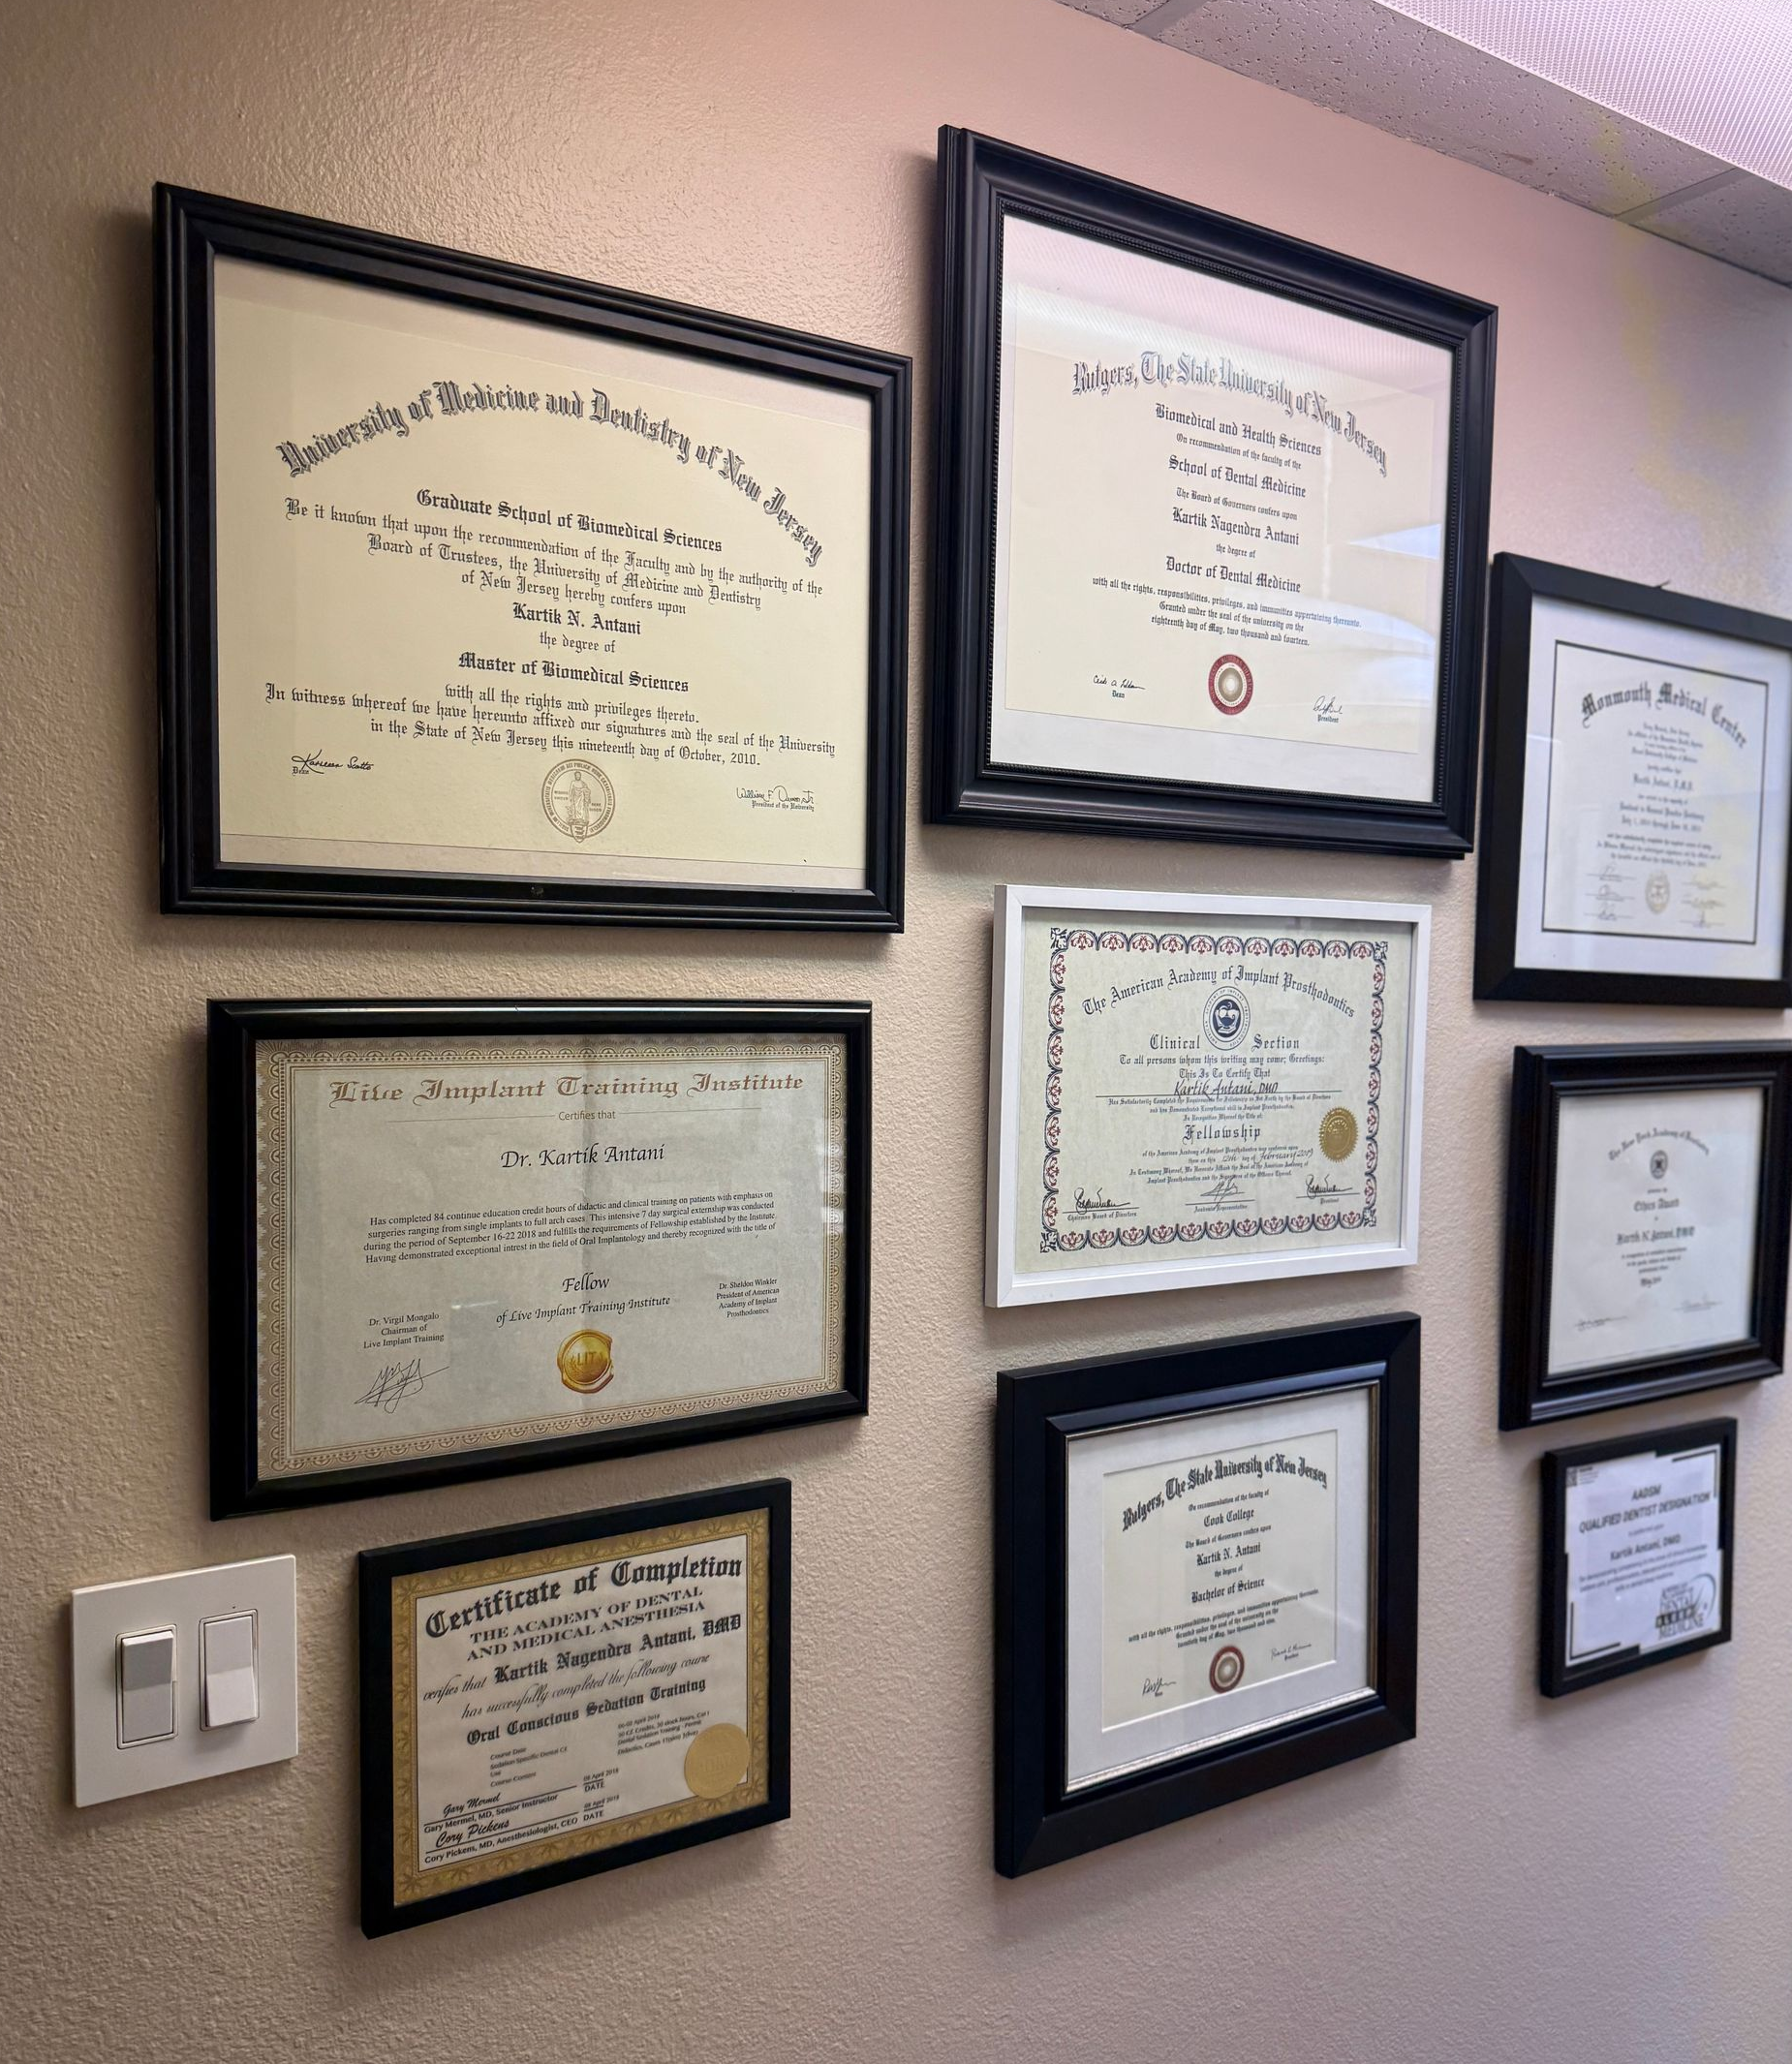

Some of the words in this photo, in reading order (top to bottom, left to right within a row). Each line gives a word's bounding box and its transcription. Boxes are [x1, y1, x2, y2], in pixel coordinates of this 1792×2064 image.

[1072, 361, 1139, 396] Rutgers,
[1141, 351, 1177, 388] The
[1176, 353, 1218, 386] State
[1219, 357, 1293, 418] University
[1293, 392, 1312, 416] of
[1312, 390, 1342, 435] New
[1340, 411, 1386, 477] Jersey
[1156, 403, 1216, 431] Biomedical
[1219, 421, 1238, 436] and
[1242, 423, 1276, 448] Health
[1279, 433, 1321, 455] Sciences
[276, 402, 410, 477] University
[408, 389, 433, 422] of
[436, 383, 541, 416] Medicine
[545, 390, 584, 419] and
[589, 387, 691, 464] Dentistry
[695, 446, 723, 470] of
[718, 448, 761, 502] New
[763, 487, 822, 568] Jersey
[1168, 454, 1207, 477] School
[1211, 466, 1222, 479] of
[1225, 467, 1257, 487] Dental
[1261, 476, 1306, 498] Medicine
[417, 489, 492, 515] Graduate
[498, 501, 551, 525] School
[557, 513, 572, 529] of
[577, 514, 658, 542] Biomedical
[664, 528, 722, 552] Sciences
[1173, 507, 1207, 528] Kartik
[1211, 514, 1260, 538] Nagendra
[1264, 526, 1299, 545] Antani
[1166, 556, 1202, 575] Doctor
[1206, 565, 1218, 578] of
[1220, 565, 1252, 585] Dental
[1255, 572, 1301, 593] Medicine
[513, 602, 562, 625] Kartik
[567, 609, 584, 628] N.
[590, 613, 640, 634] Antani
[1199, 622, 1207, 631] of
[459, 652, 515, 673] Master
[521, 661, 538, 675] of
[541, 661, 624, 685] Biomedical
[629, 671, 688, 692] Sciences
[1582, 681, 1652, 726] Monmouth
[1655, 682, 1707, 716] Medical
[1712, 704, 1746, 748] Center
[1082, 997, 1106, 1015] The
[1110, 978, 1163, 1008] American
[1167, 968, 1217, 991] Academy
[1221, 965, 1234, 980] of
[1234, 965, 1279, 986] Implant
[1282, 971, 1354, 1017] Prosthodontics
[1119, 1054, 1131, 1064] To
[1134, 1055, 1144, 1064] all
[1147, 1058, 1176, 1066] persons
[1179, 1054, 1201, 1066] whom
[1204, 1054, 1218, 1066] this
[1220, 1055, 1247, 1066] writing
[1250, 1057, 1264, 1066] may
[1288, 1054, 1324, 1065] Greetings:
[1150, 1034, 1200, 1050] Clinical
[1251, 1033, 1299, 1050] Section
[329, 1081, 403, 1109] Live
[413, 1079, 546, 1106] Implant
[556, 1075, 679, 1101] Training
[687, 1073, 803, 1097] Institute
[1179, 1068, 1196, 1080] This
[1197, 1067, 1209, 1080] Is
[1212, 1067, 1222, 1078] To
[1225, 1067, 1251, 1080] Certify
[1253, 1067, 1270, 1080] That
[559, 1108, 596, 1122] Certifies
[596, 1109, 616, 1120] that
[1182, 1124, 1260, 1143] Fellowship
[501, 1151, 532, 1168] Dr.
[539, 1144, 599, 1166] Kartik
[604, 1144, 664, 1162] Antani
[562, 1273, 609, 1293] Fellow
[383, 1315, 404, 1325] Virgil
[406, 1312, 439, 1324] Mongalo
[496, 1309, 508, 1326] of
[508, 1309, 532, 1321] Live
[535, 1304, 577, 1321] Implant
[579, 1301, 625, 1313] Training
[627, 1297, 670, 1309] Institute
[1123, 1492, 1164, 1531] Rutgers,
[1165, 1477, 1186, 1500] The
[1187, 1464, 1214, 1491] State
[1215, 1455, 1263, 1480] University
[1264, 1456, 1276, 1472] of
[1275, 1453, 1296, 1475] New
[1298, 1457, 1327, 1489] Jersey
[1632, 1486, 1661, 1500] AADSM
[1204, 1513, 1224, 1527] Cook
[1226, 1508, 1254, 1523] College
[1579, 1513, 1622, 1533] QUALIFIED
[1623, 1503, 1657, 1522] DENTIST
[1658, 1492, 1710, 1513] DESIGNATION
[1196, 1551, 1221, 1566] Kartik
[1223, 1548, 1232, 1560] N.
[1235, 1542, 1260, 1557] Antani
[1611, 1548, 1633, 1560] Kartik
[1663, 1534, 1681, 1547] DMD
[425, 1581, 561, 1638] Certificate
[573, 1566, 600, 1594] of
[610, 1555, 742, 1587] Completion
[1191, 1587, 1225, 1603] Bachelor
[1227, 1582, 1236, 1595] of
[1237, 1579, 1264, 1592] Science
[467, 1644, 507, 1661] AND
[513, 1625, 596, 1651] MEDICAL
[600, 1601, 705, 1632] ANESTHESIA
[470, 1626, 509, 1644] THE
[513, 1606, 602, 1636] ACADEMY
[607, 1601, 631, 1615] OF
[635, 1587, 702, 1610] DENTAL
[423, 1679, 458, 1704] verifies
[462, 1675, 487, 1692] that
[494, 1658, 548, 1684] Kartik
[557, 1643, 632, 1670] Nagendra
[702, 1614, 741, 1637] DMD
[461, 1703, 482, 1719] has
[486, 1683, 549, 1713] successfully
[552, 1672, 607, 1699] completed
[607, 1669, 626, 1687] the
[625, 1659, 677, 1685] following
[681, 1654, 710, 1668] course
[467, 1725, 500, 1745] Oral
[507, 1710, 579, 1736] Conscious
[586, 1694, 644, 1717] Sedation
[650, 1679, 706, 1701] Training
[424, 1824, 444, 1833] Gary
[446, 1814, 477, 1829] Mermel,
[478, 1810, 492, 1820] MD,
[496, 1802, 520, 1815] Senior
[522, 1795, 558, 1808] Instructor
